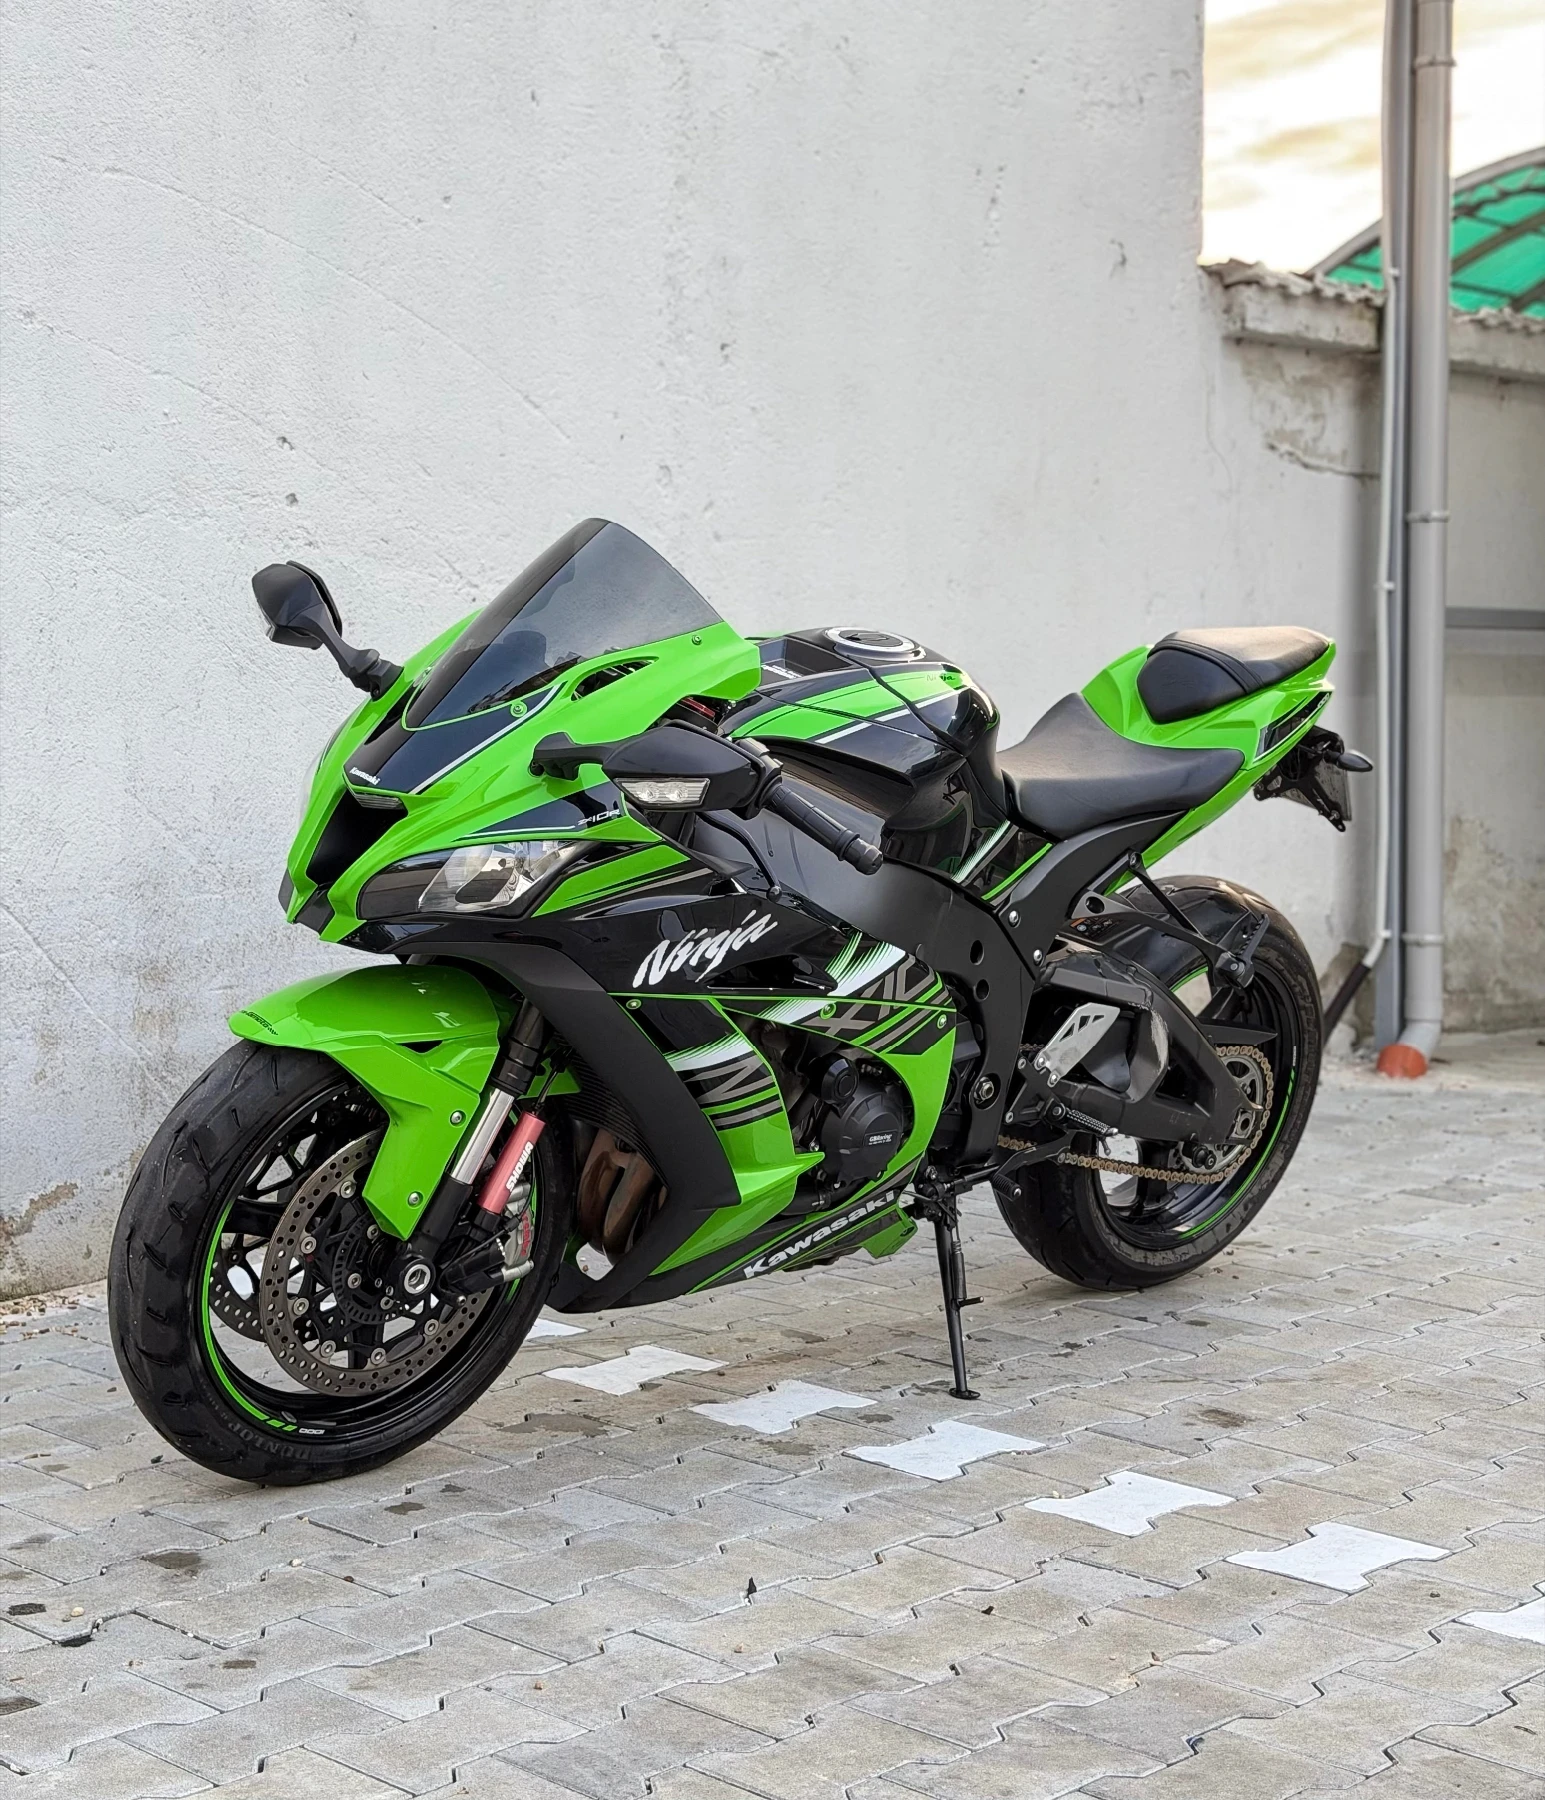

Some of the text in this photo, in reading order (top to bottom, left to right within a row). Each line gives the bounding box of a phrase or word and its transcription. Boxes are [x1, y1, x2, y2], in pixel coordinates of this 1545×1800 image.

[632, 909, 778, 988] Ninja
[505, 1141, 534, 1192] SHOWA
[743, 1190, 895, 1279] Kawasaki
[228, 1422, 312, 1460] DUNLOP
